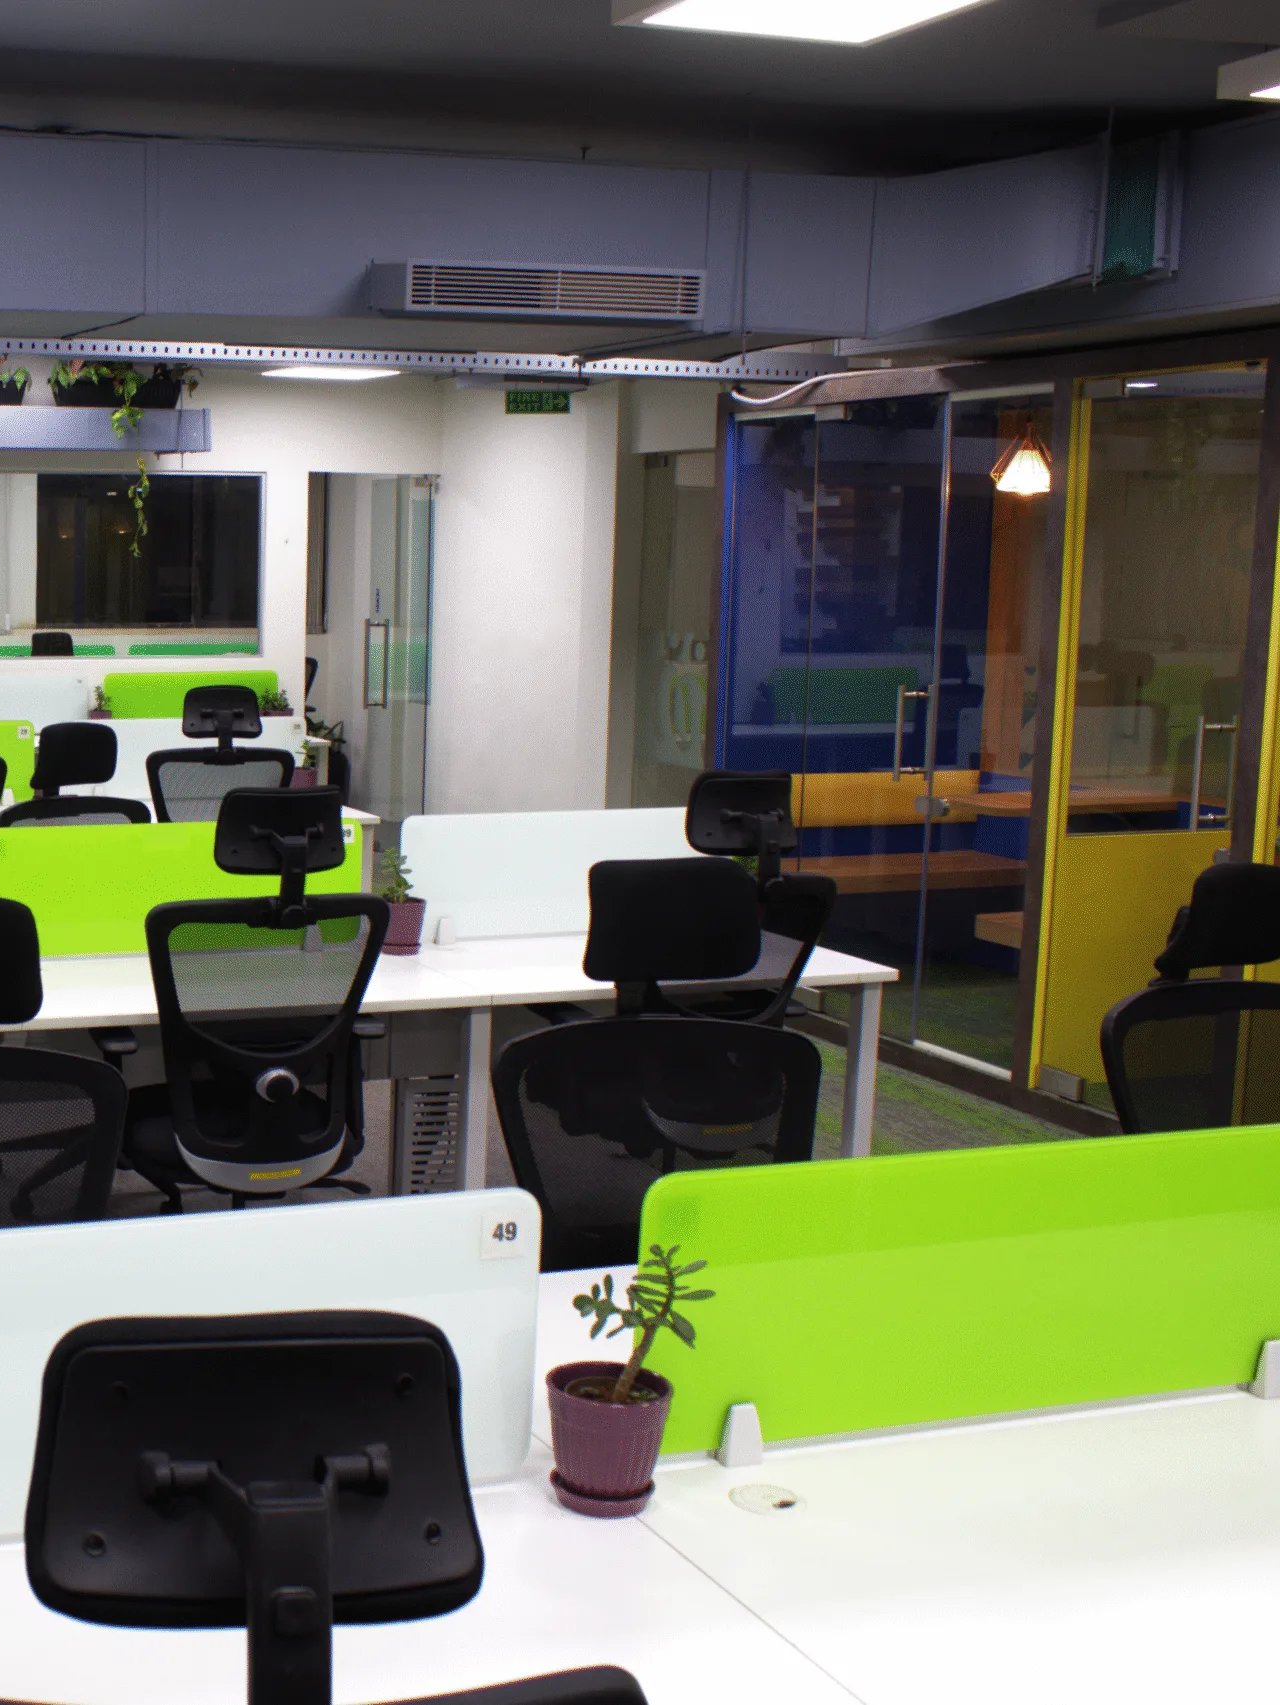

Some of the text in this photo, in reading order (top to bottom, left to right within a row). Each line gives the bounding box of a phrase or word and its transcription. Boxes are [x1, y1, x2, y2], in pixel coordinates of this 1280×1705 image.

[509, 393, 539, 401] FIRE
[509, 403, 540, 411] EXIT
[492, 1221, 518, 1242] 49
